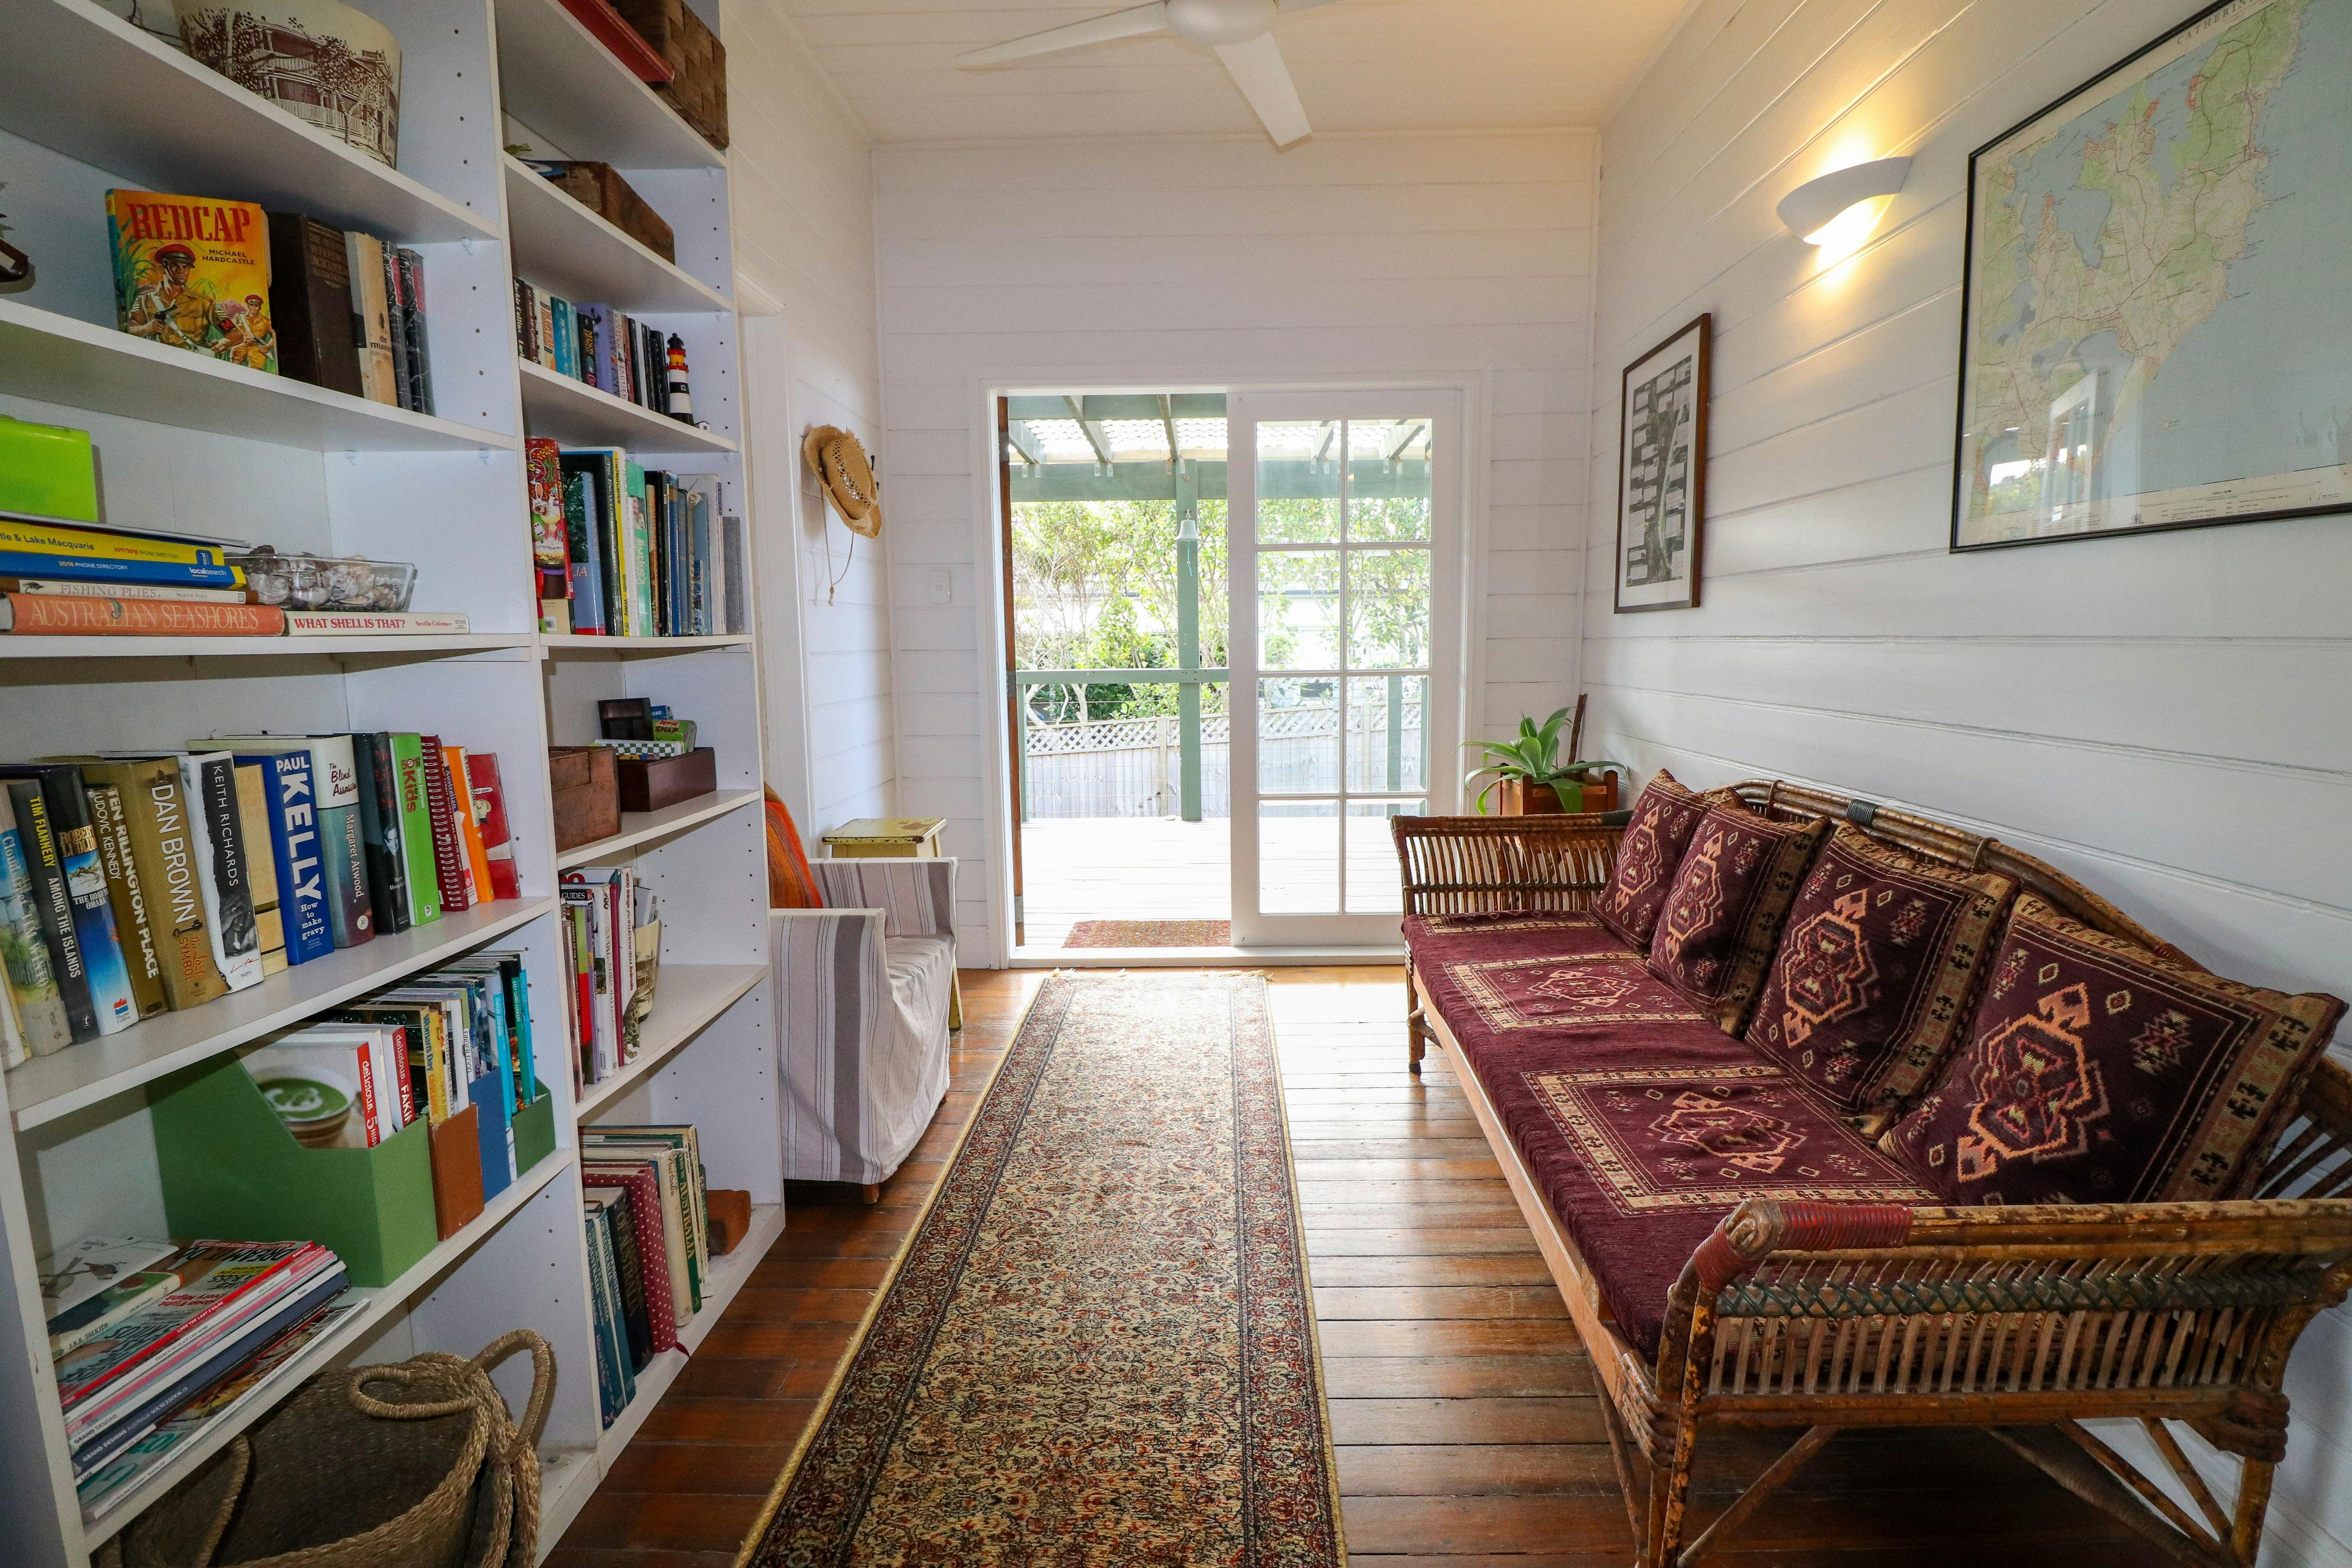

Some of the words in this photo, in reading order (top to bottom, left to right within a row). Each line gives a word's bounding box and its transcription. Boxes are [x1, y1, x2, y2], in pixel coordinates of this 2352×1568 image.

[127, 203, 251, 242] REDCAP
[202, 255, 255, 265] HARDCASTLE
[209, 249, 247, 258] MICHAEL
[14, 534, 22, 542] &
[23, 535, 46, 544] Lake
[47, 537, 94, 550] Macquarie
[60, 584, 116, 596] FISHING
[188, 567, 227, 576] localsearch
[29, 600, 158, 627] AUSTRALIAN
[161, 605, 260, 629] SEASHORES
[294, 618, 328, 628] WHAT
[330, 619, 364, 628] SHELL
[364, 619, 374, 628] IS
[375, 619, 405, 628] THAT?
[276, 756, 310, 773] PAUL
[331, 768, 350, 783] Blind
[464, 756, 472, 777] KYLIE
[468, 778, 476, 806] KWONG
[108, 789, 124, 821] TEN
[213, 765, 228, 808] KEITH
[403, 769, 418, 813] Kids
[445, 769, 457, 809] Australian
[30, 796, 44, 817] TIM
[152, 784, 181, 834] DAN
[34, 818, 56, 867] FLANNERY
[220, 813, 239, 887] RICHARDS
[281, 772, 322, 900] KELLY
[345, 813, 358, 858] Margaret
[102, 835, 122, 880] KENNEDY
[115, 824, 147, 925] RILLINGTON
[47, 877, 66, 914] AMONG
[160, 837, 197, 924] BROWN
[351, 860, 365, 898] Atwood
[73, 895, 90, 905] THE
[300, 902, 318, 912] How
[56, 914, 71, 935] THE
[301, 918, 323, 929] make
[302, 926, 325, 940] gravy
[62, 936, 82, 979] ISLANDS
[138, 926, 160, 979] PLACE
[179, 937, 195, 983] SYMBOL
[367, 1115, 378, 1130] 5
[668, 1158, 677, 1197] Australia
[616, 1212, 628, 1230] OF
[675, 1181, 699, 1260] AUSTRALIA
[292, 1248, 304, 1258] MARCH
[609, 1256, 622, 1310] HOMESTEADS
[619, 1234, 641, 1318] AUSTRALIA
[84, 1322, 110, 1339] TOLKIEN
[177, 1323, 191, 1334] LOSE
[190, 1317, 199, 1325] THE
[198, 1310, 209, 1319] LAST
[211, 1300, 224, 1311] KILOS
[154, 1349, 171, 1362] THERE'S
[176, 1337, 190, 1348] PLACE
[196, 1334, 212, 1347] AUGUST
[73, 1427, 96, 1445] GRAND
[94, 1412, 118, 1431] DESIGNS
[297, 1287, 308, 1296] Issue
[82, 1445, 104, 1463] GRAND
[102, 1428, 128, 1448] DESIGNS
[126, 1412, 151, 1431] AUSTRALIA
[149, 1390, 183, 1415] SOURCEBOOK
